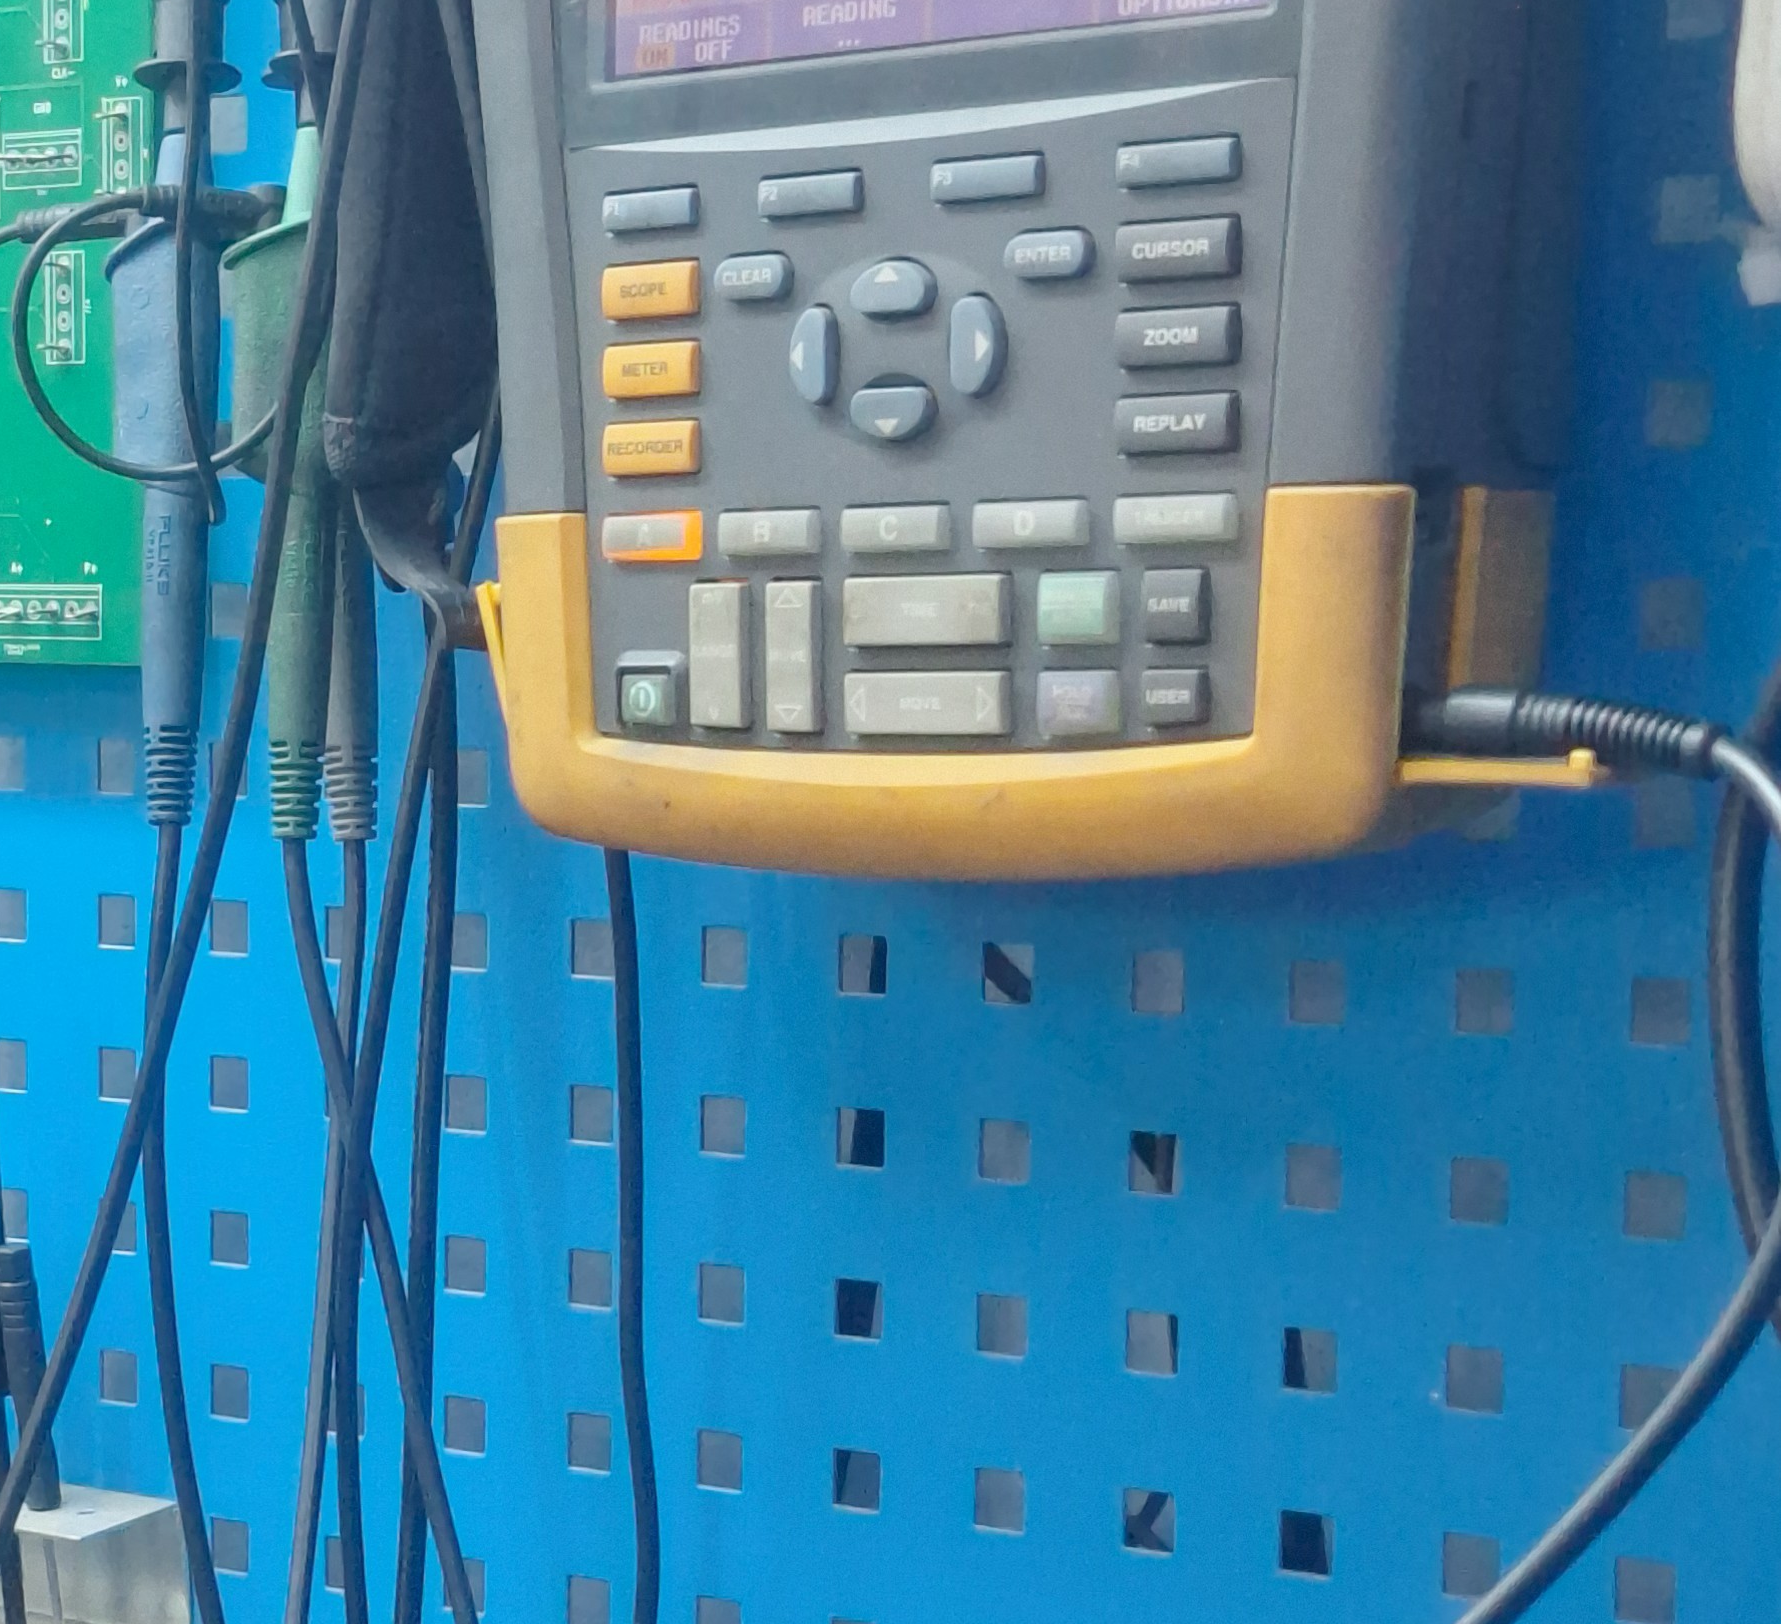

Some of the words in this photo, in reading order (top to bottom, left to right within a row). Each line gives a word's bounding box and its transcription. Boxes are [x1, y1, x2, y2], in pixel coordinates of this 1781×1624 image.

[638, 13, 741, 46] READINGS
[693, 39, 737, 64] OFF
[1013, 243, 1072, 265] ENTER
[1130, 237, 1211, 261] CURSOR
[721, 267, 773, 287] CLEAR
[619, 281, 668, 300] SCOPE
[1142, 325, 1200, 347] ZOOM
[620, 361, 669, 378] METER
[1132, 412, 1208, 435] REPLAY
[606, 438, 684, 458] RECORDER
[753, 520, 771, 543] B
[878, 513, 899, 542] C
[157, 514, 173, 598] FLUKE
[1146, 596, 1191, 614] SAVE
[1145, 688, 1191, 705] USER
